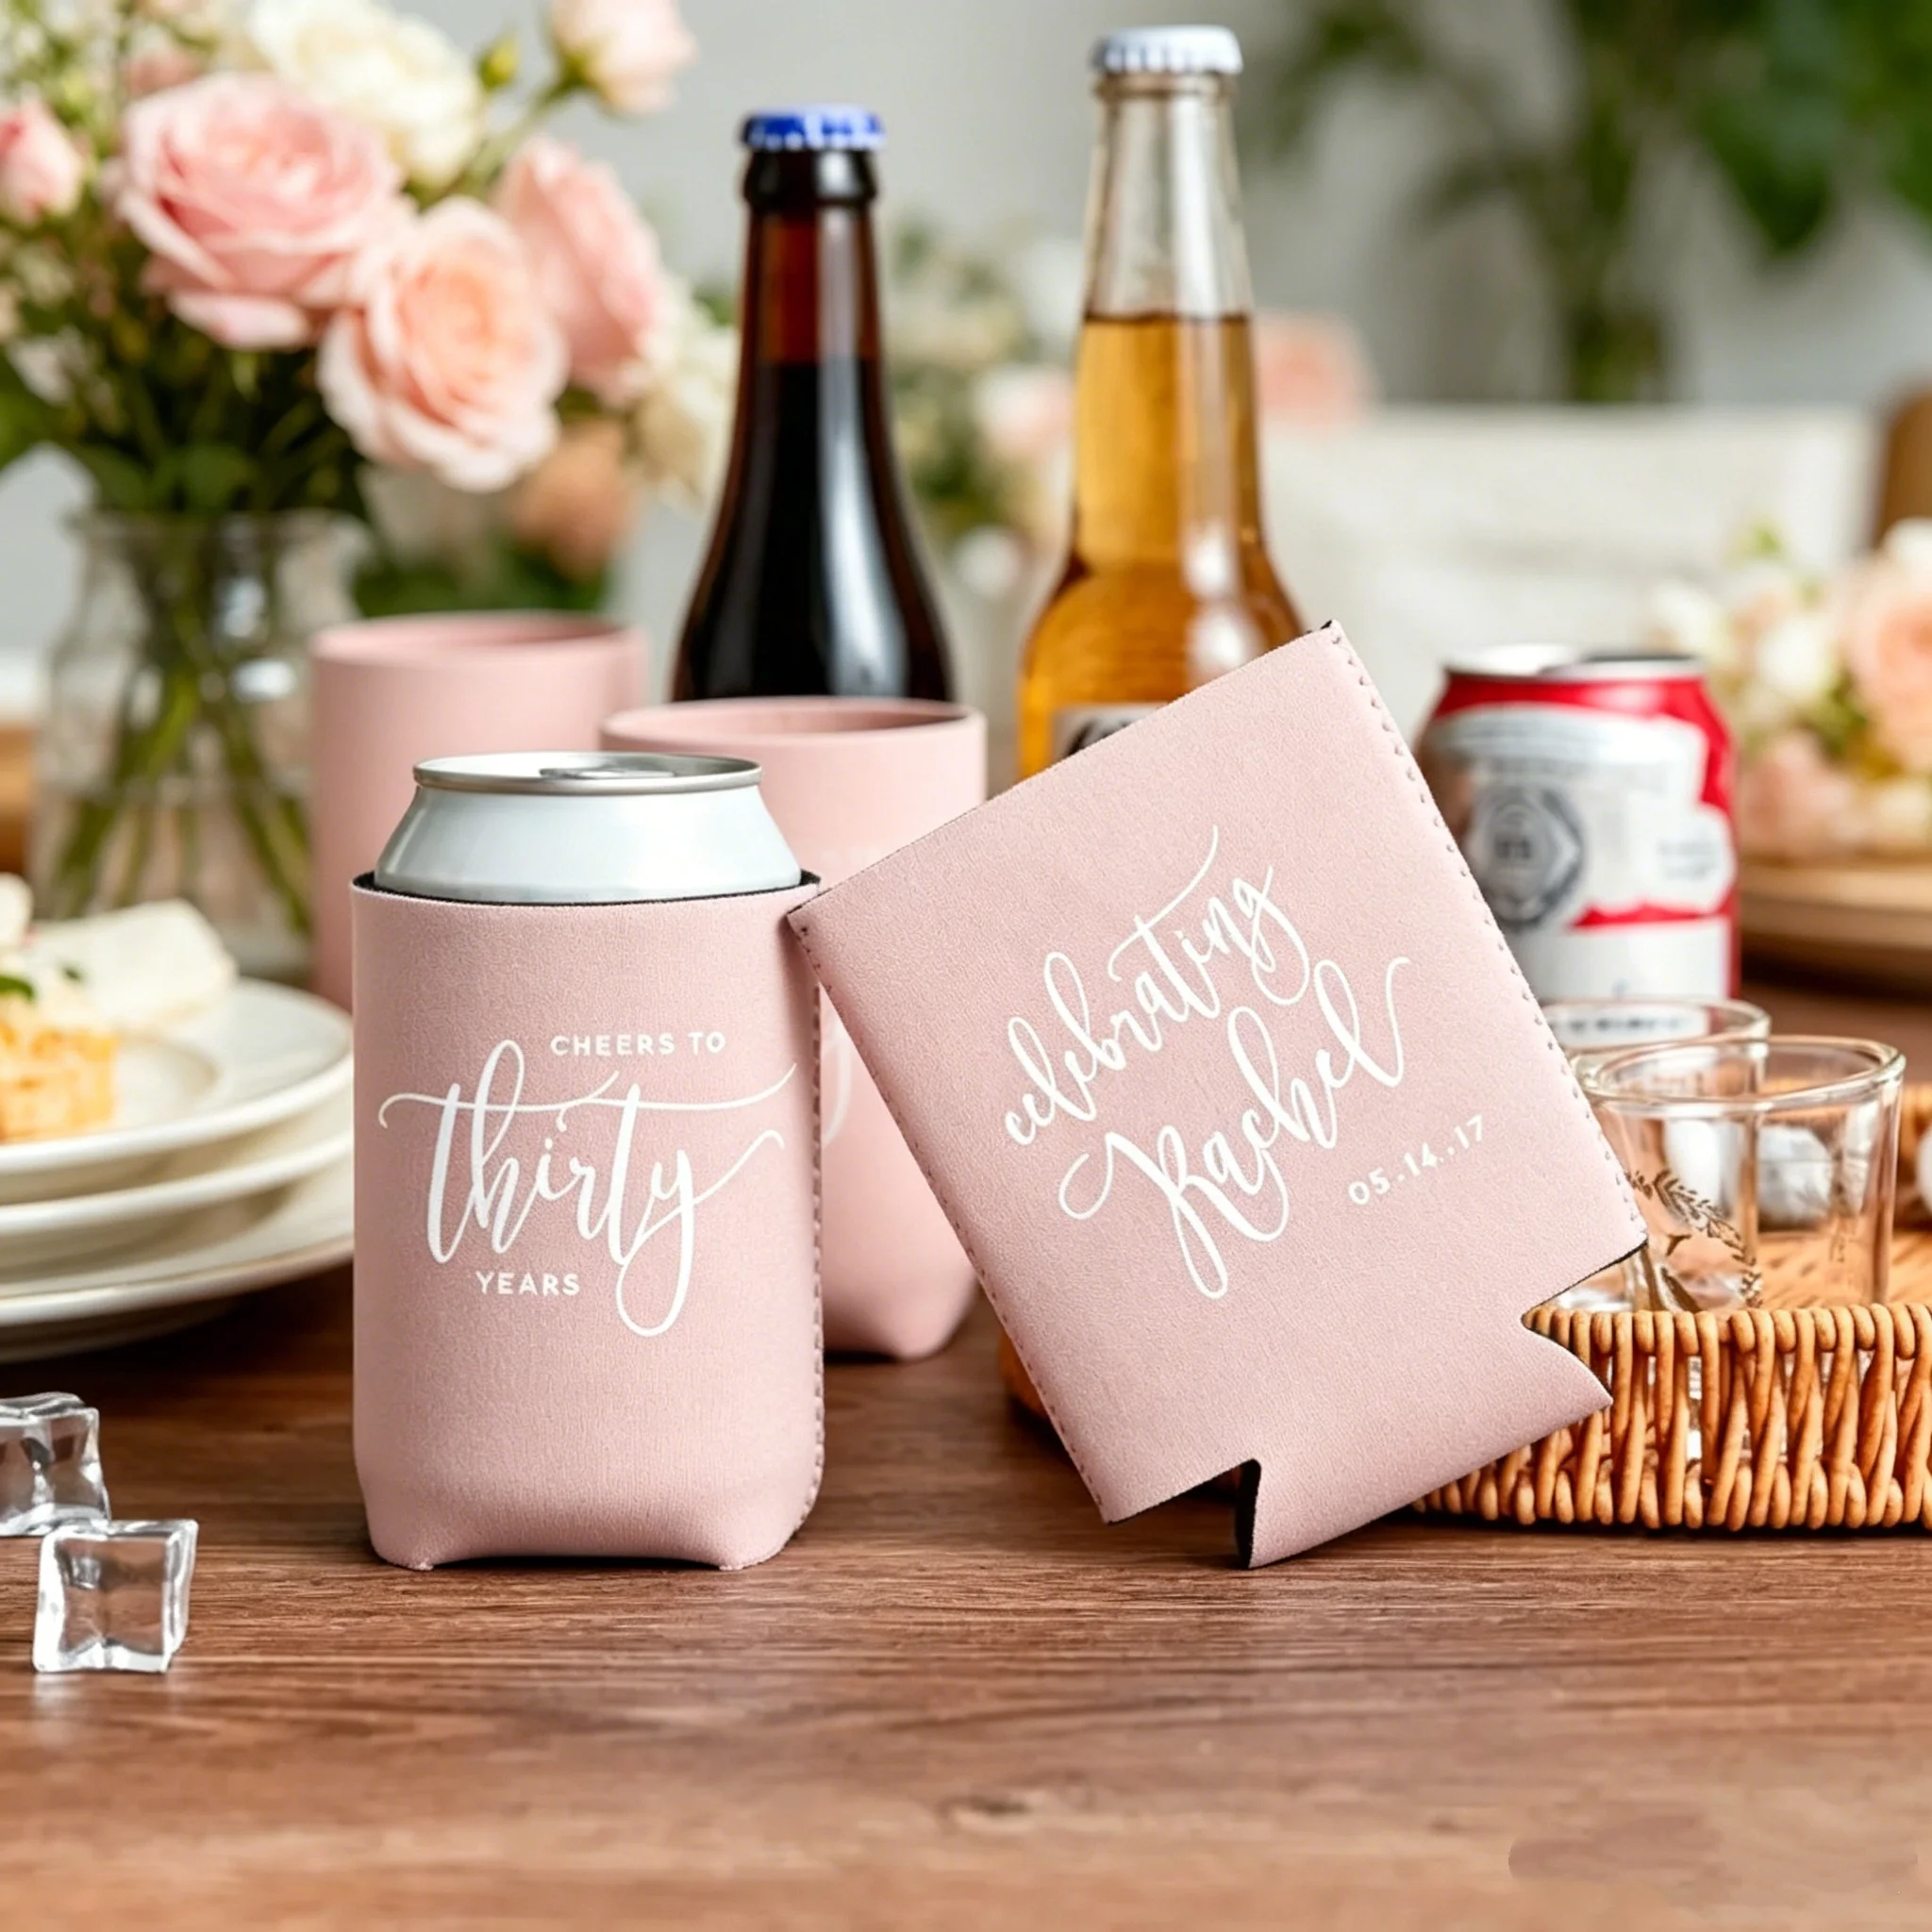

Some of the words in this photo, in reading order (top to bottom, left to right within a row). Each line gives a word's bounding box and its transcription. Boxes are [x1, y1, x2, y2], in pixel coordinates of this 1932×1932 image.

[549, 1032, 676, 1058] CHEERS
[690, 1030, 727, 1055] TO
[1004, 824, 1310, 1146] celebrating
[1058, 956, 1410, 1301] Rachel
[378, 1039, 798, 1339] thirty
[475, 1271, 581, 1297] YEARS
